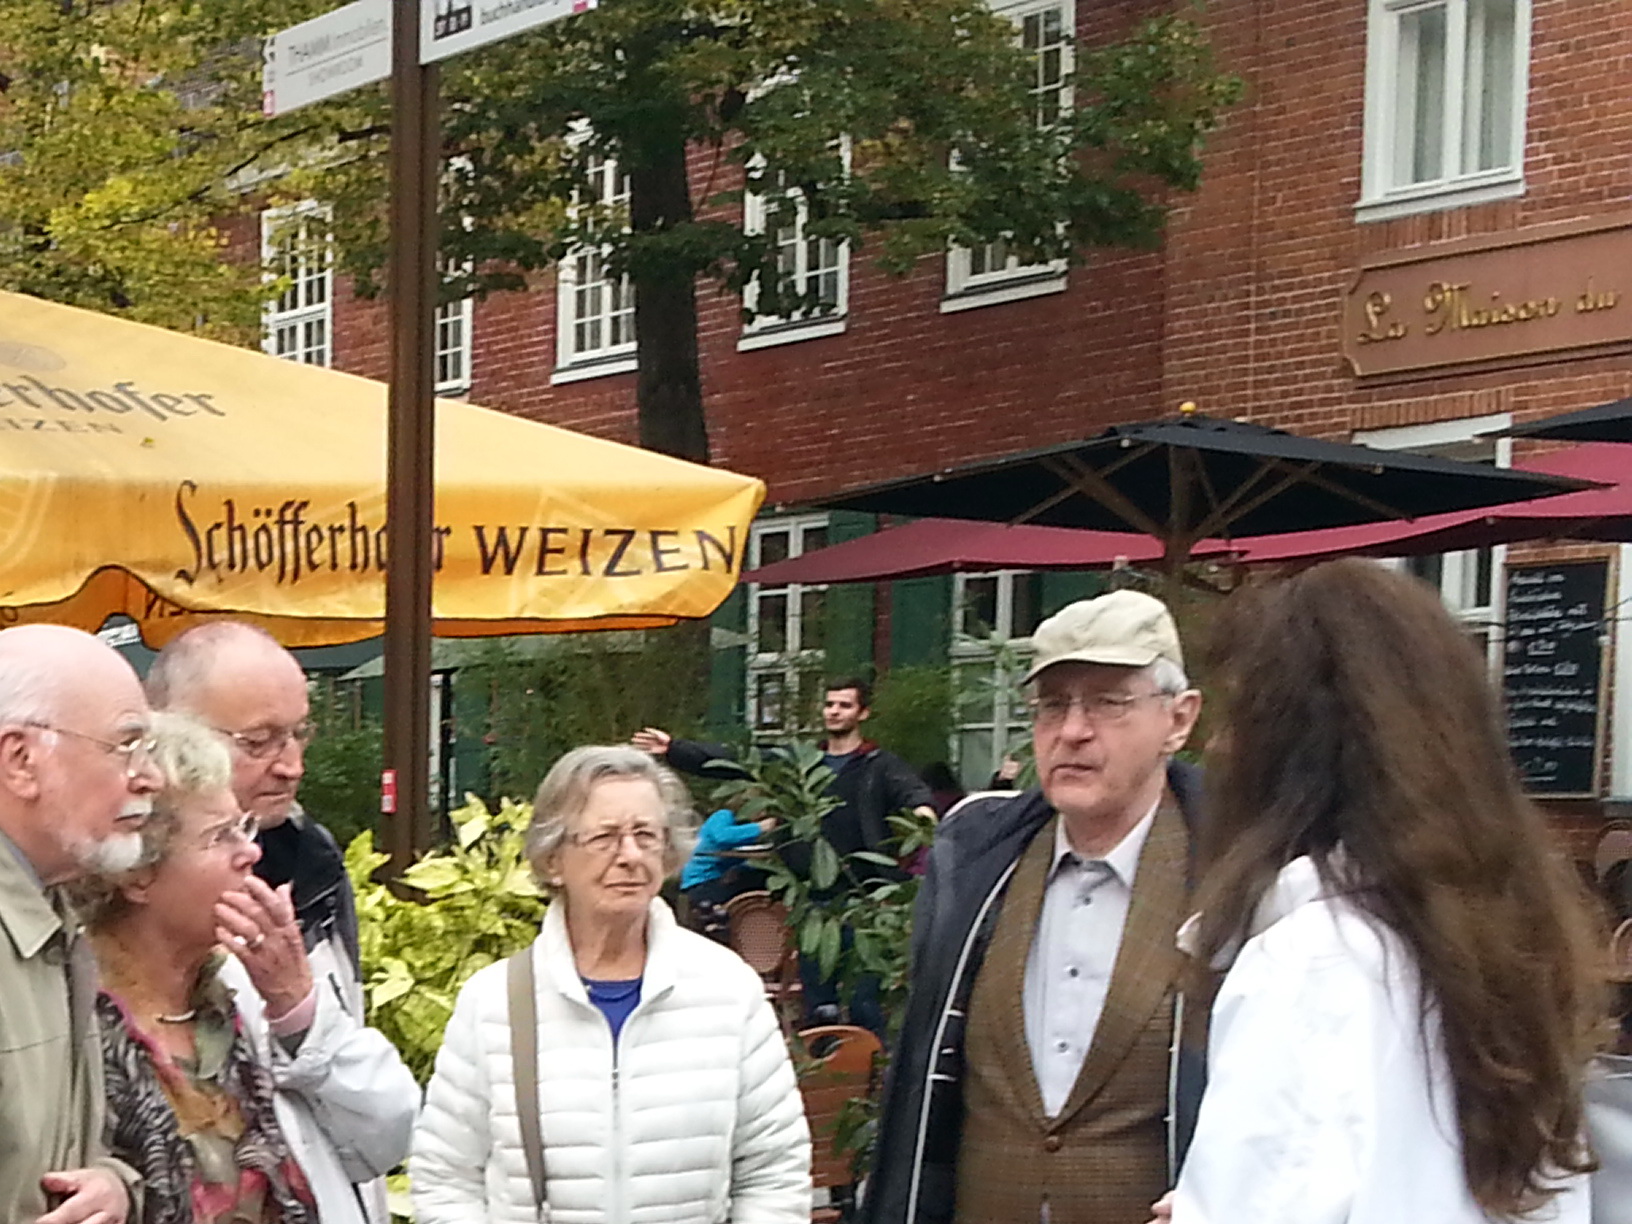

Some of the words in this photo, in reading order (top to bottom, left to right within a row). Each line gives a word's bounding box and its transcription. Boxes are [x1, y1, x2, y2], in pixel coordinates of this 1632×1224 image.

[1356, 289, 1408, 345] La
[1424, 280, 1561, 337] Maison
[1576, 275, 1622, 314] du
[472, 525, 738, 578] WEIZEN
